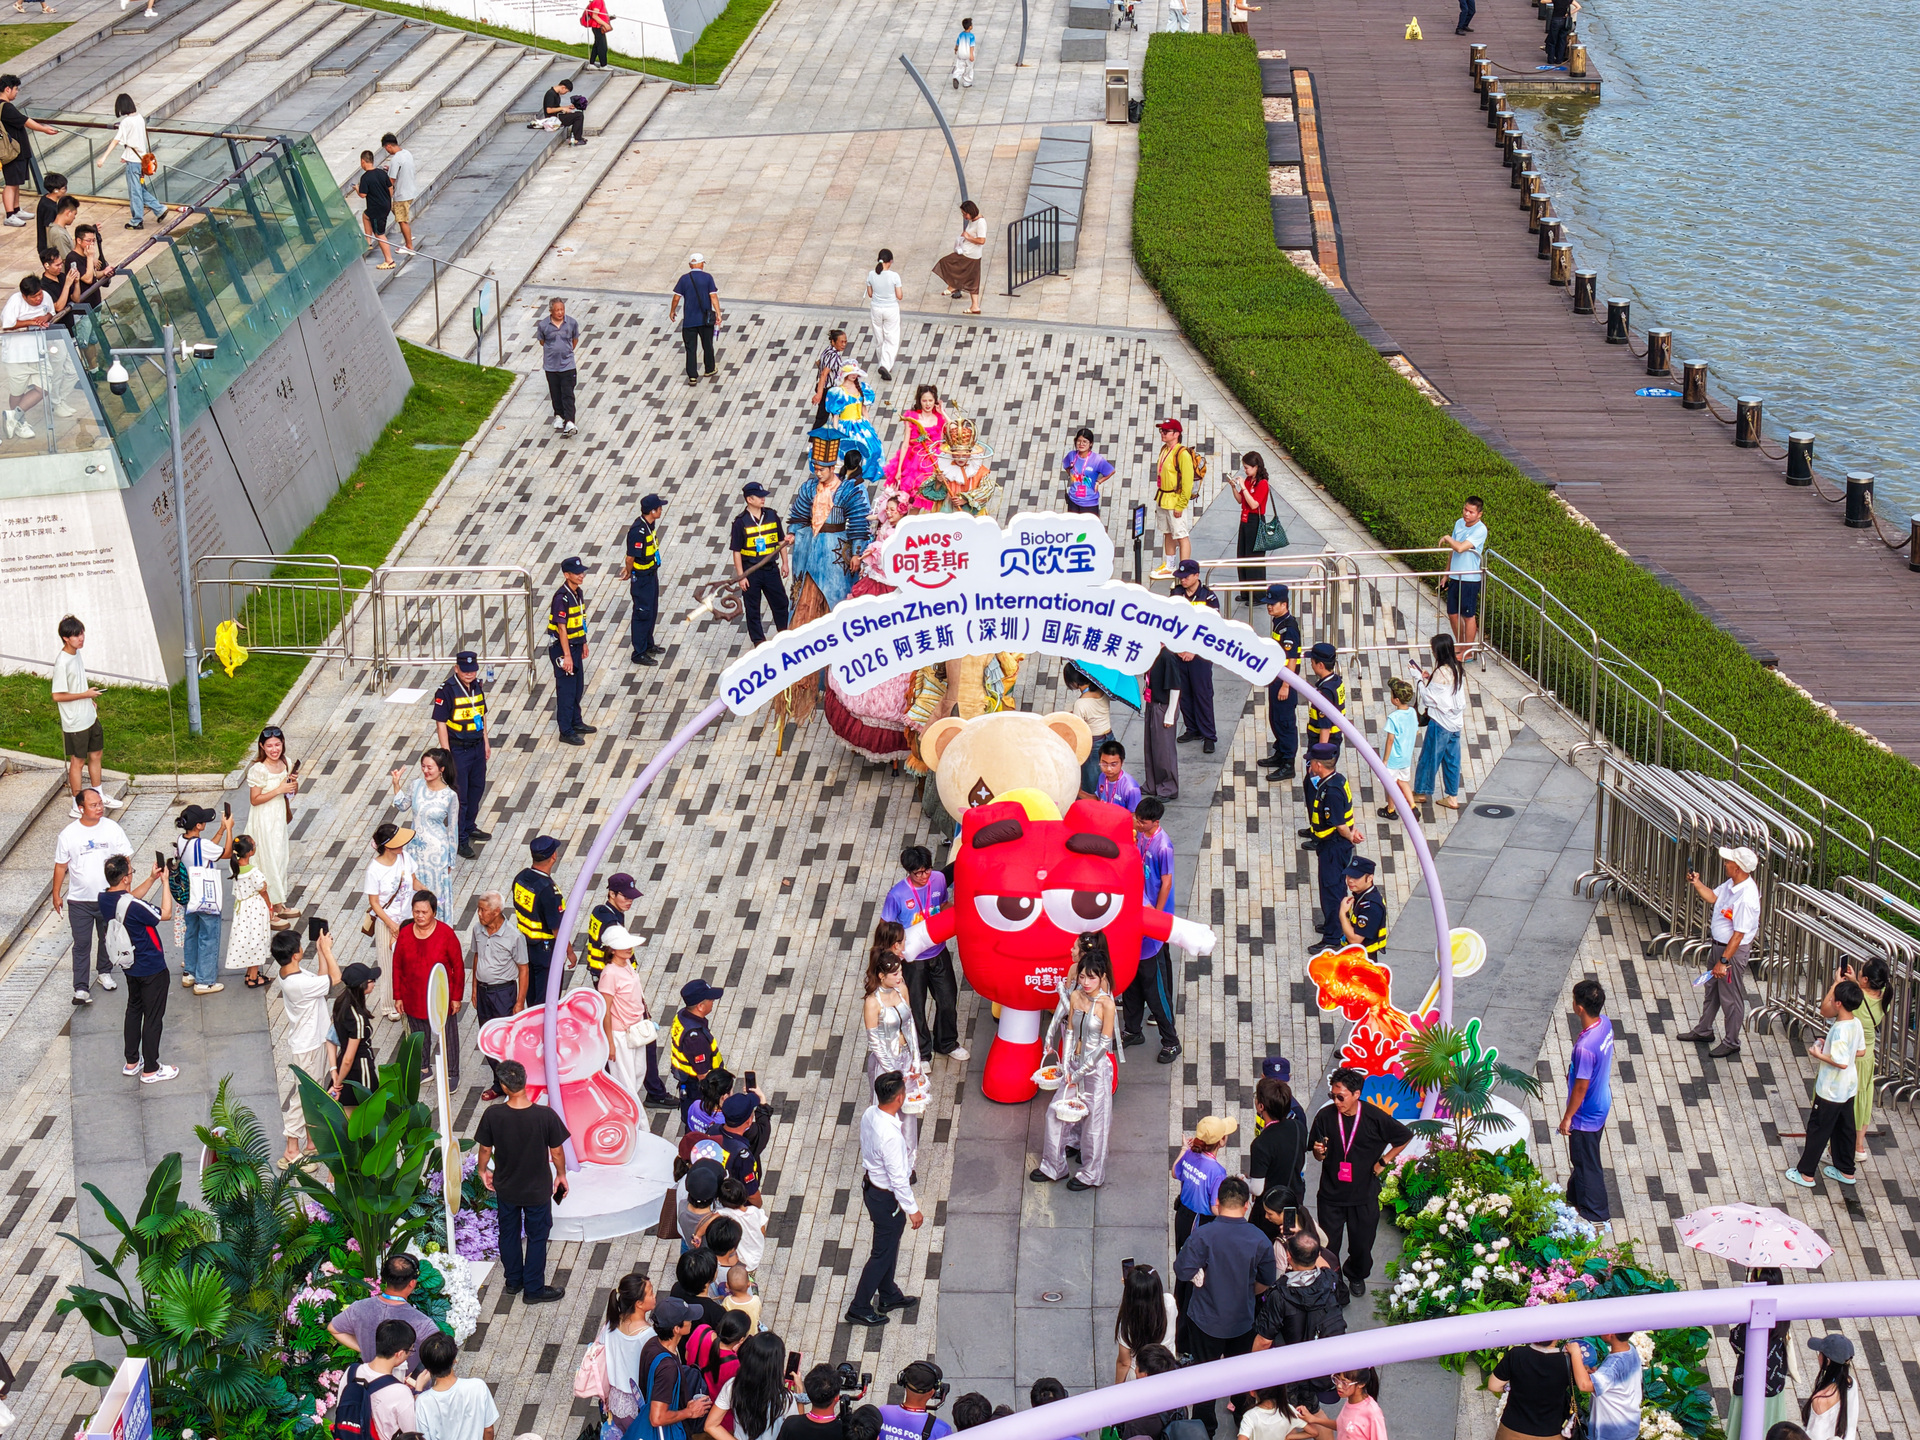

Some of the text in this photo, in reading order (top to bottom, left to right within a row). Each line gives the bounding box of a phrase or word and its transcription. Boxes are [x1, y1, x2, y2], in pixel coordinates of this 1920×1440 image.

[1020, 530, 1074, 546] Biobor
[29, 563, 56, 571] fishermen
[892, 549, 970, 574] 阿麦斯
[1000, 544, 1096, 578] 贝欧宝
[727, 592, 1270, 705] 2026 Amos (ShenZhen) International Candy Festival
[839, 616, 1144, 685] 2026 阿麦斯（深圳）国际糖果节
[880, 1422, 903, 1437] AMOS
